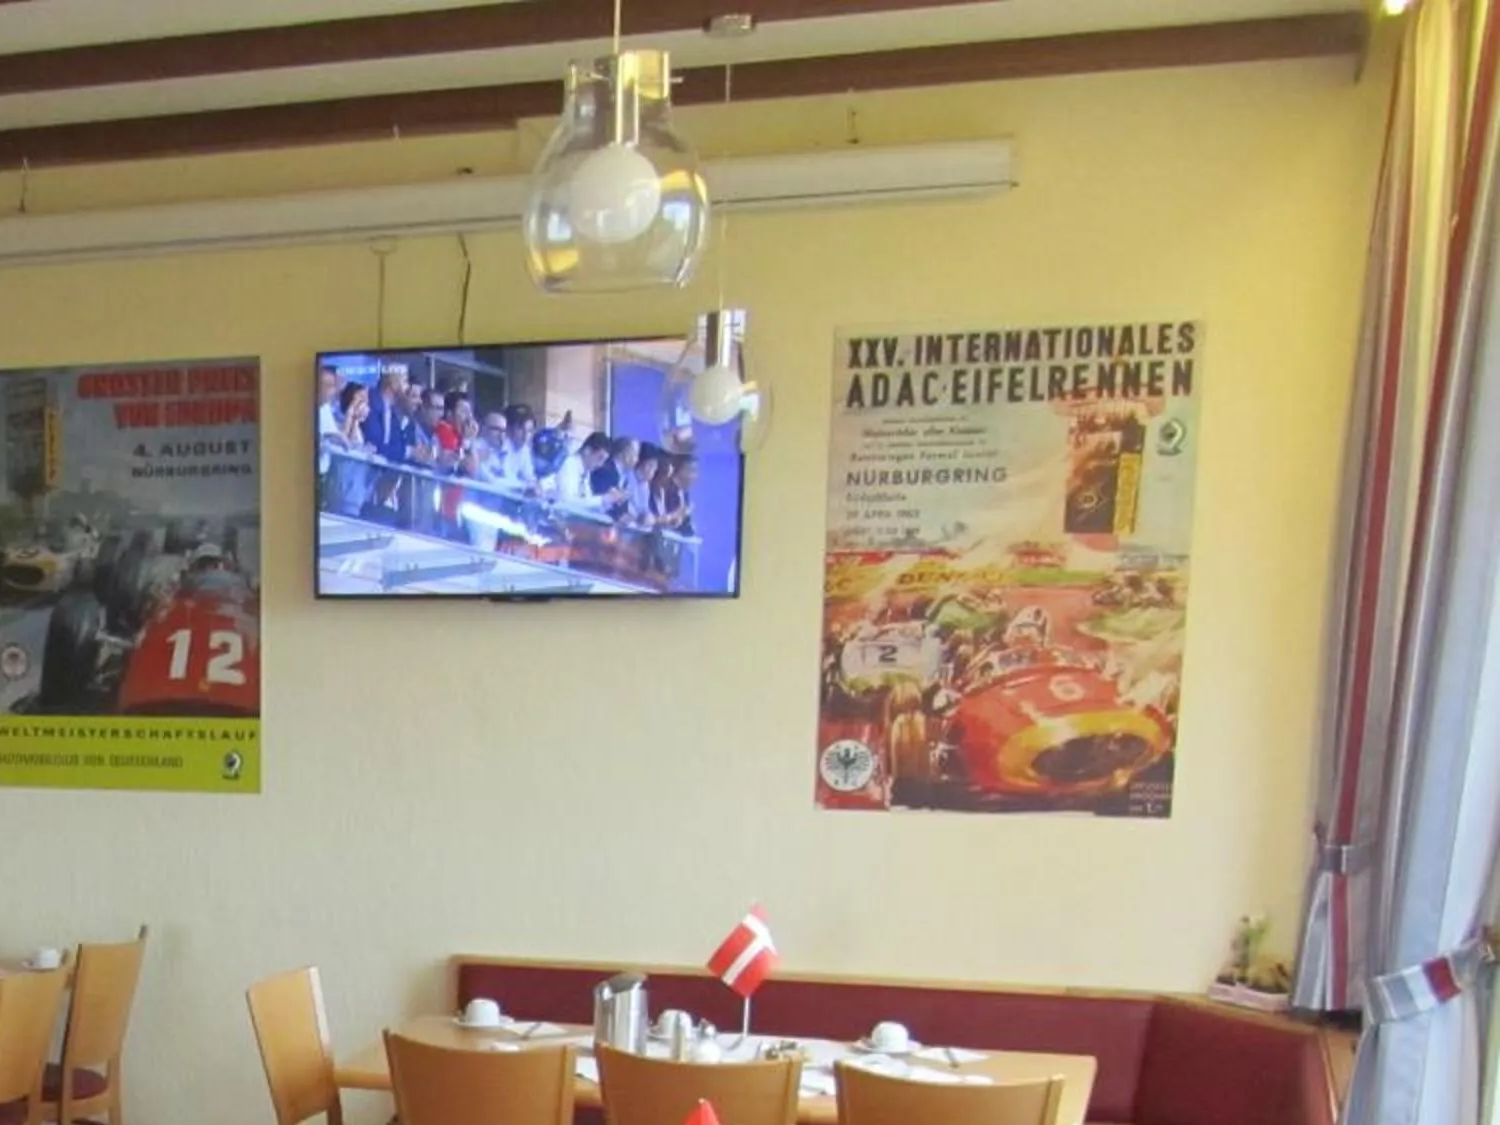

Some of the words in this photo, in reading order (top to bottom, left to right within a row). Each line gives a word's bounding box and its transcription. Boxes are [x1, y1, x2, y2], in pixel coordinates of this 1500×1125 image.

[847, 337, 904, 369] XXV.
[913, 322, 1196, 365] INTERNATIONALES
[159, 438, 251, 458] AUGUST
[166, 629, 247, 685] 12
[877, 645, 898, 663] 2
[1051, 675, 1085, 701] 6
